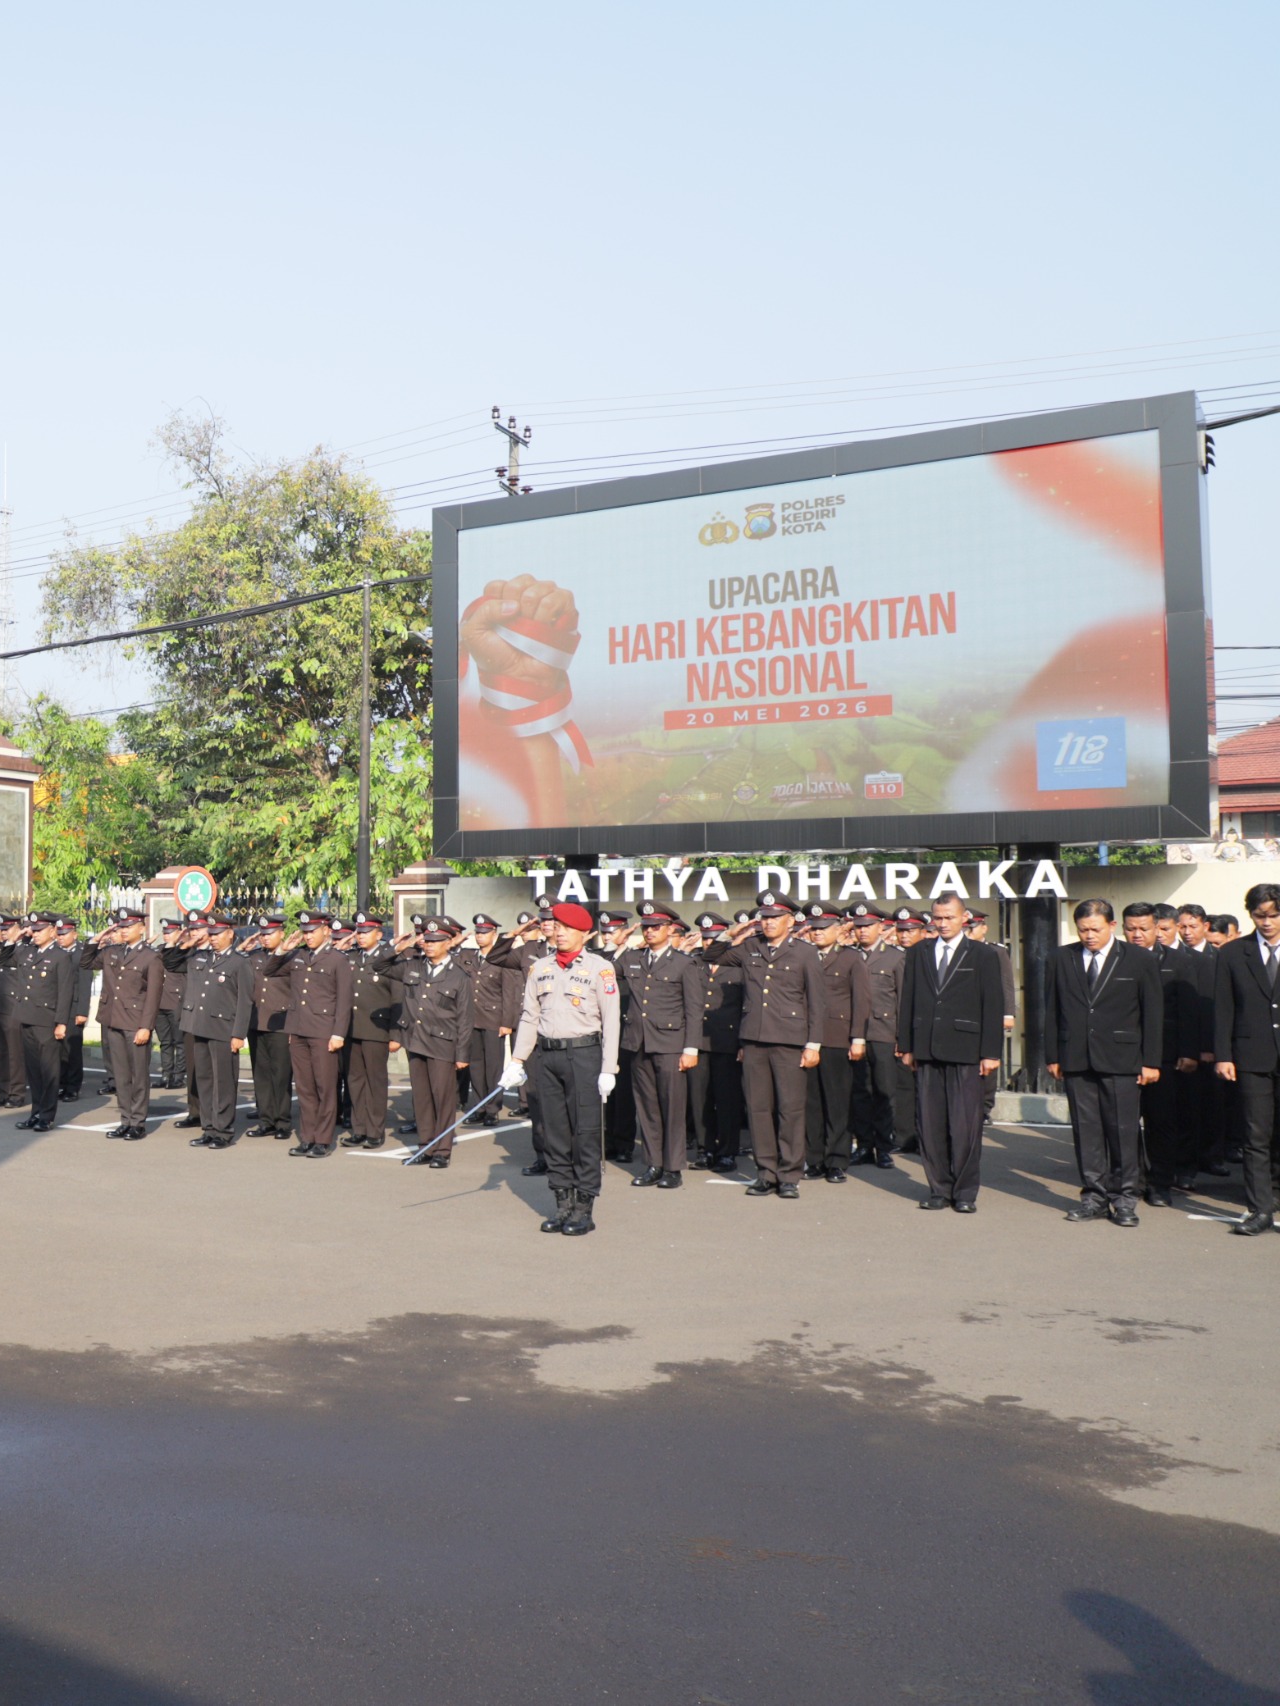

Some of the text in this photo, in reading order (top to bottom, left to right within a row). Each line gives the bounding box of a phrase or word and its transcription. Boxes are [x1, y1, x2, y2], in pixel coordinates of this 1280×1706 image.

[781, 494, 846, 513] POLRES
[781, 507, 836, 525] KEDIRI
[781, 521, 826, 537] KOTA
[709, 566, 840, 610] UPACARA
[608, 591, 957, 665] HARI KEBANGKITAN
[686, 649, 868, 703] NASIONAL
[686, 700, 868, 726] 20 MEI 2026
[871, 783, 897, 795] 110
[527, 859, 1069, 902] TATHYA DHARAKA
[569, 975, 592, 986] POLRI
